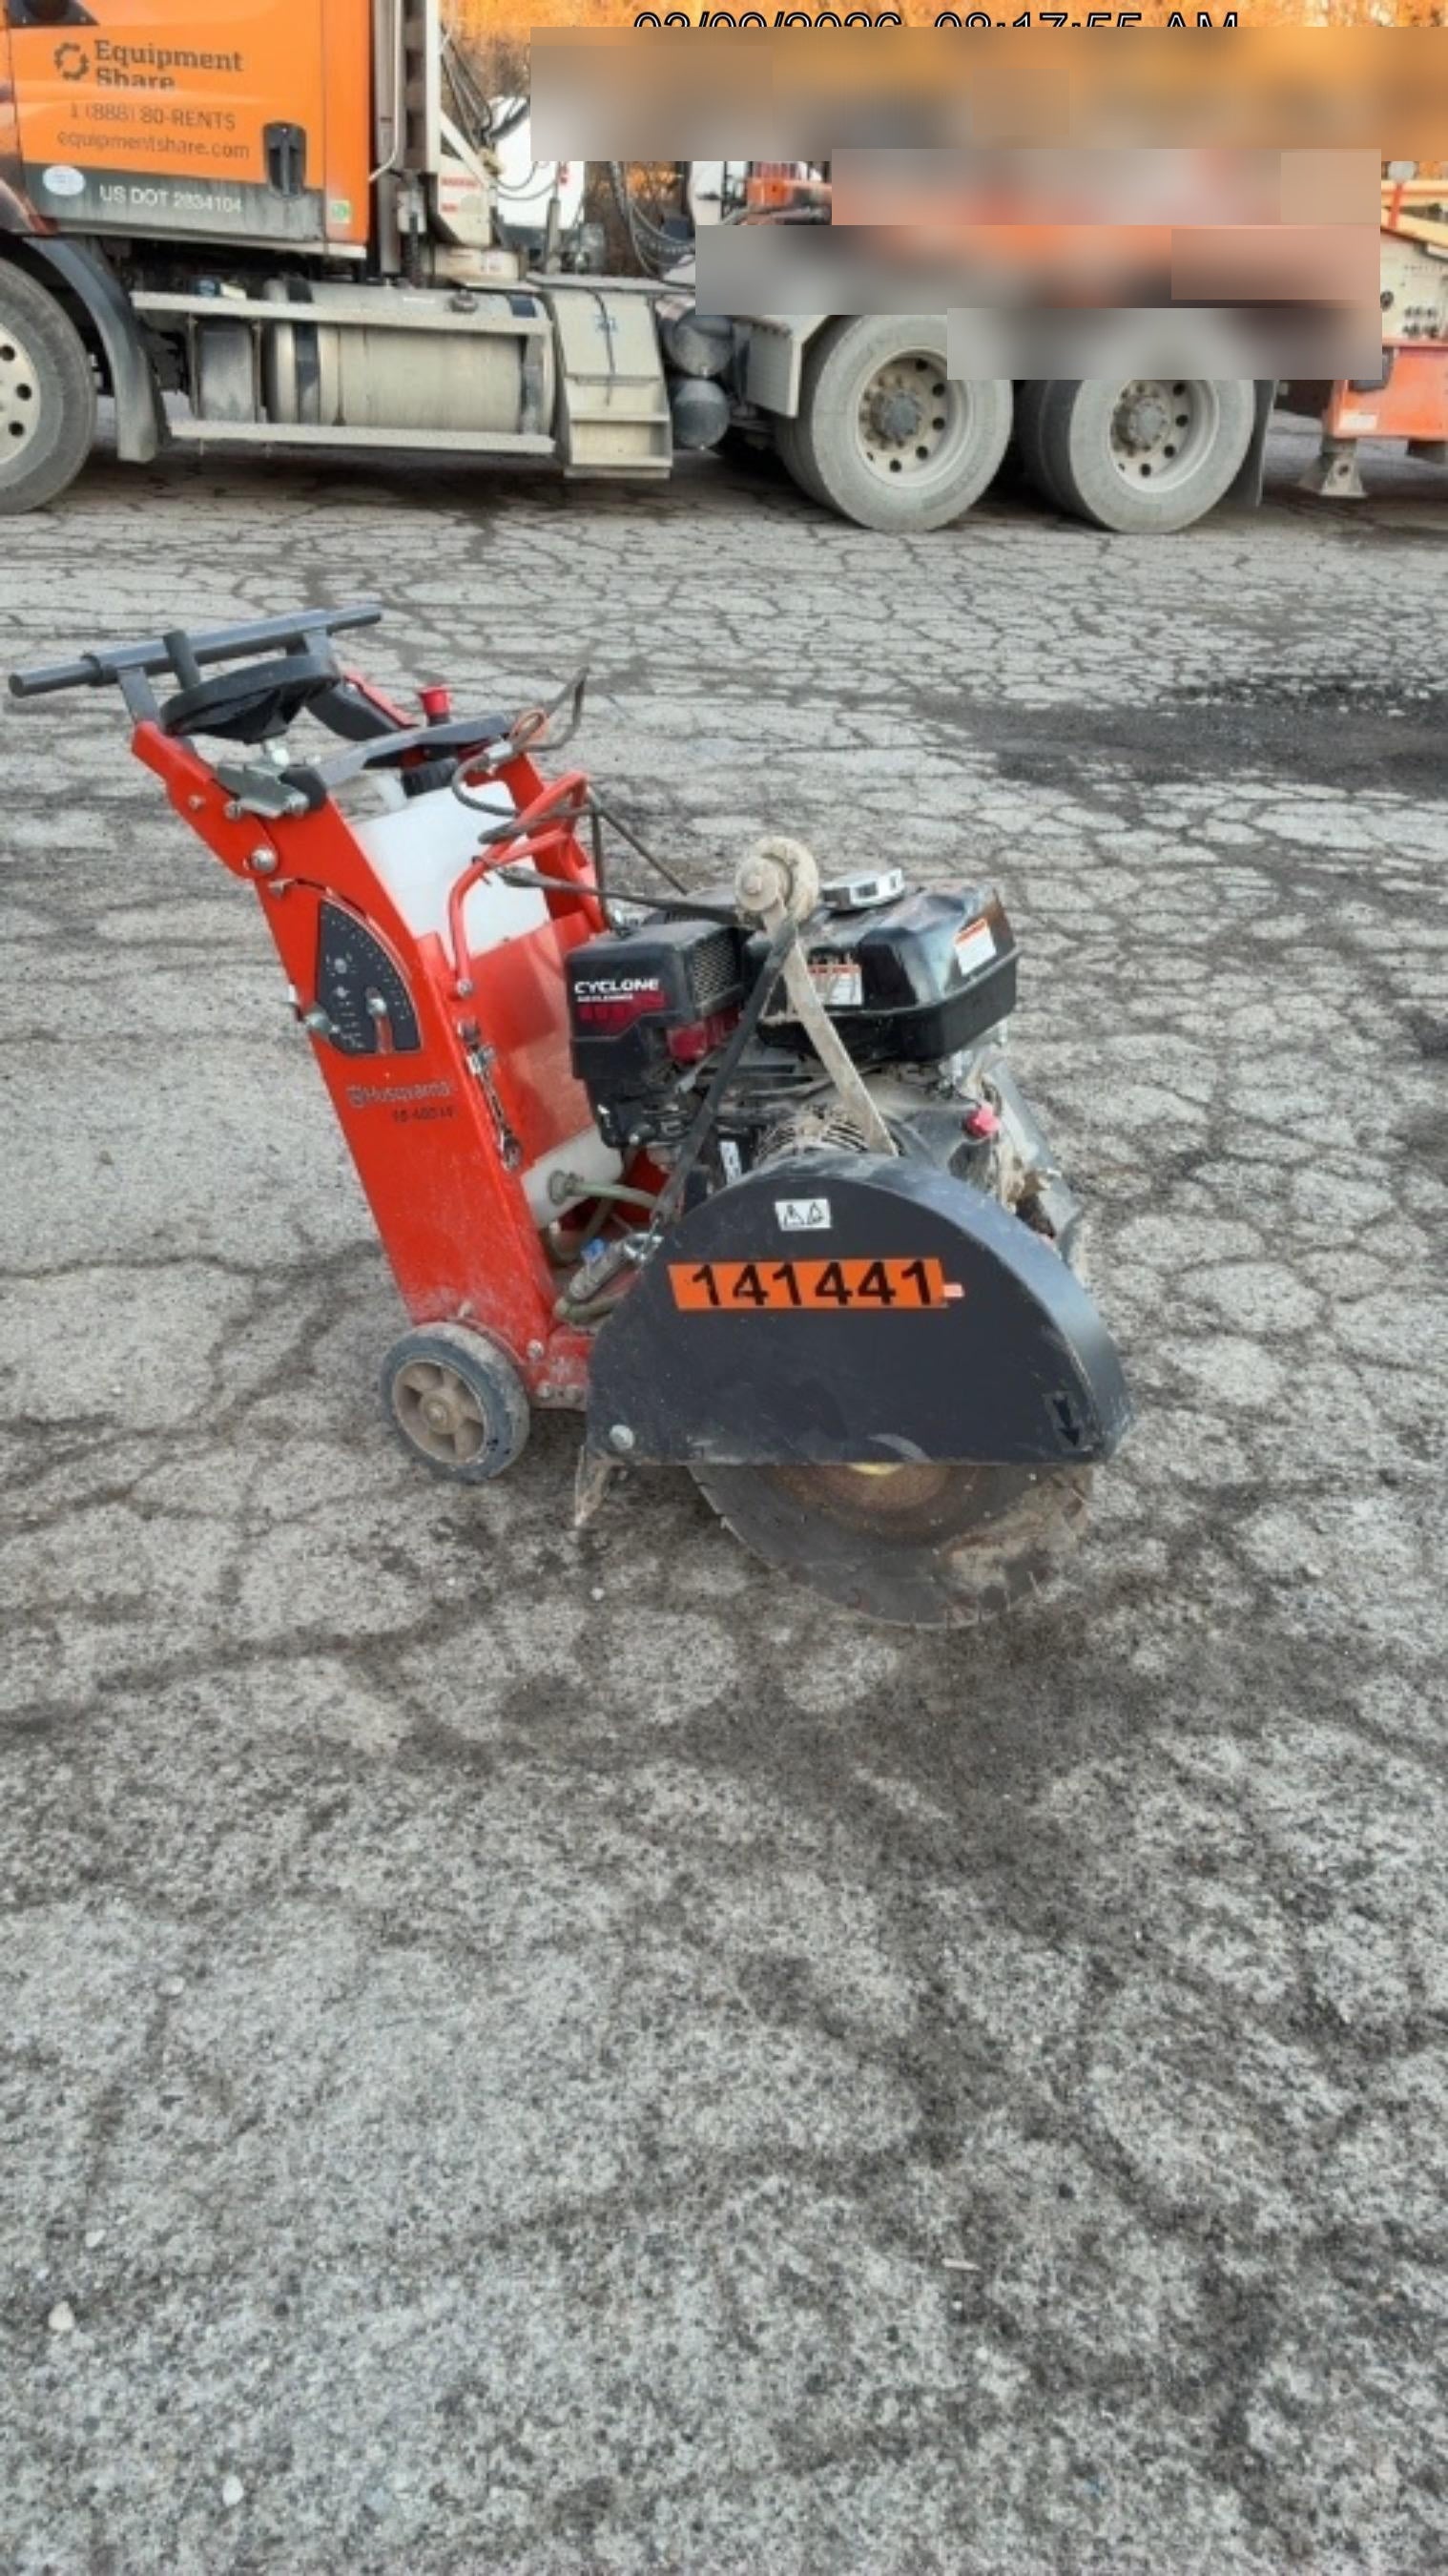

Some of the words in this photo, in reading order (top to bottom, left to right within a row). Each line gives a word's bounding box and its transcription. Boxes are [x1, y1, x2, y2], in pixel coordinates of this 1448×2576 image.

[93, 39, 244, 72] Equipment
[95, 68, 176, 90] Share
[139, 106, 237, 132] 80-RENTS
[57, 131, 250, 160] equipmentshare.com
[99, 184, 126, 204] US
[131, 187, 169, 208] DOT
[574, 978, 660, 994] CYCLONE
[692, 1259, 932, 1306] 141441
